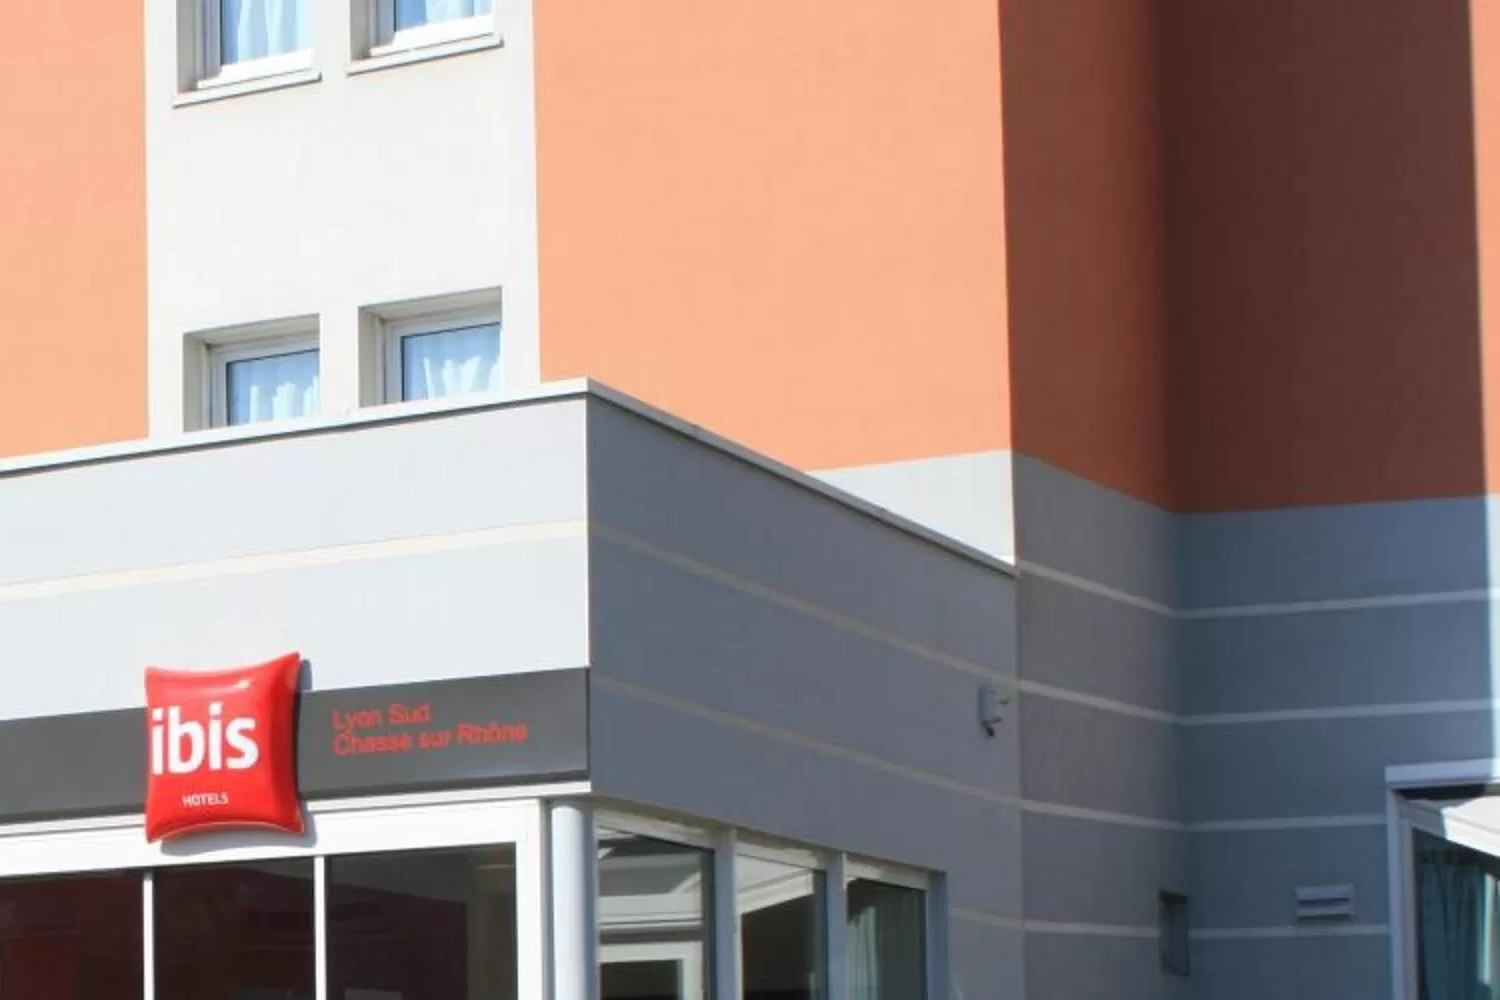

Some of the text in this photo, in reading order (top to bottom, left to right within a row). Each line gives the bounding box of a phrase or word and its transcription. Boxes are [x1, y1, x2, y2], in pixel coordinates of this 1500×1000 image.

[332, 702, 431, 735] Lyon Sud
[151, 701, 260, 776] ibis
[333, 733, 411, 756] Chasse
[419, 730, 451, 750] sur
[181, 792, 230, 807] HOTELS
